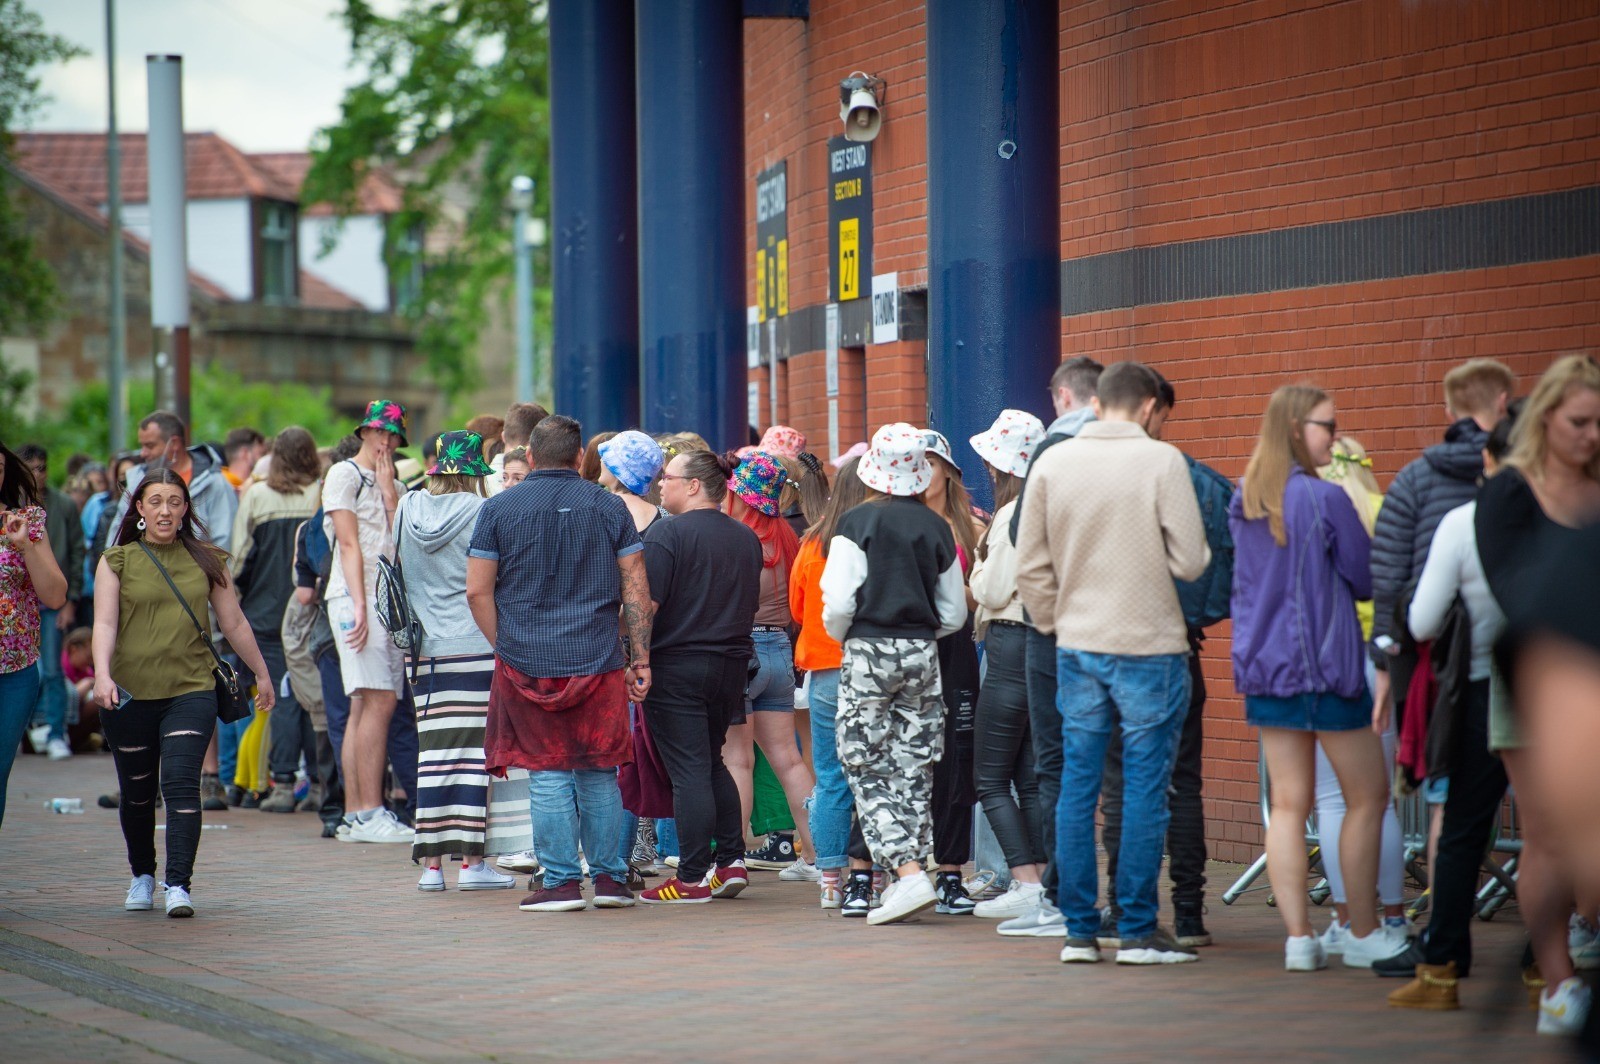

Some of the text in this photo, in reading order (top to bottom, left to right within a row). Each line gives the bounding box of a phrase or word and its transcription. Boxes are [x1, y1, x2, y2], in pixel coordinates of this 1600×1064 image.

[831, 145, 866, 173] WEST STAND
[843, 249, 855, 292] 27
